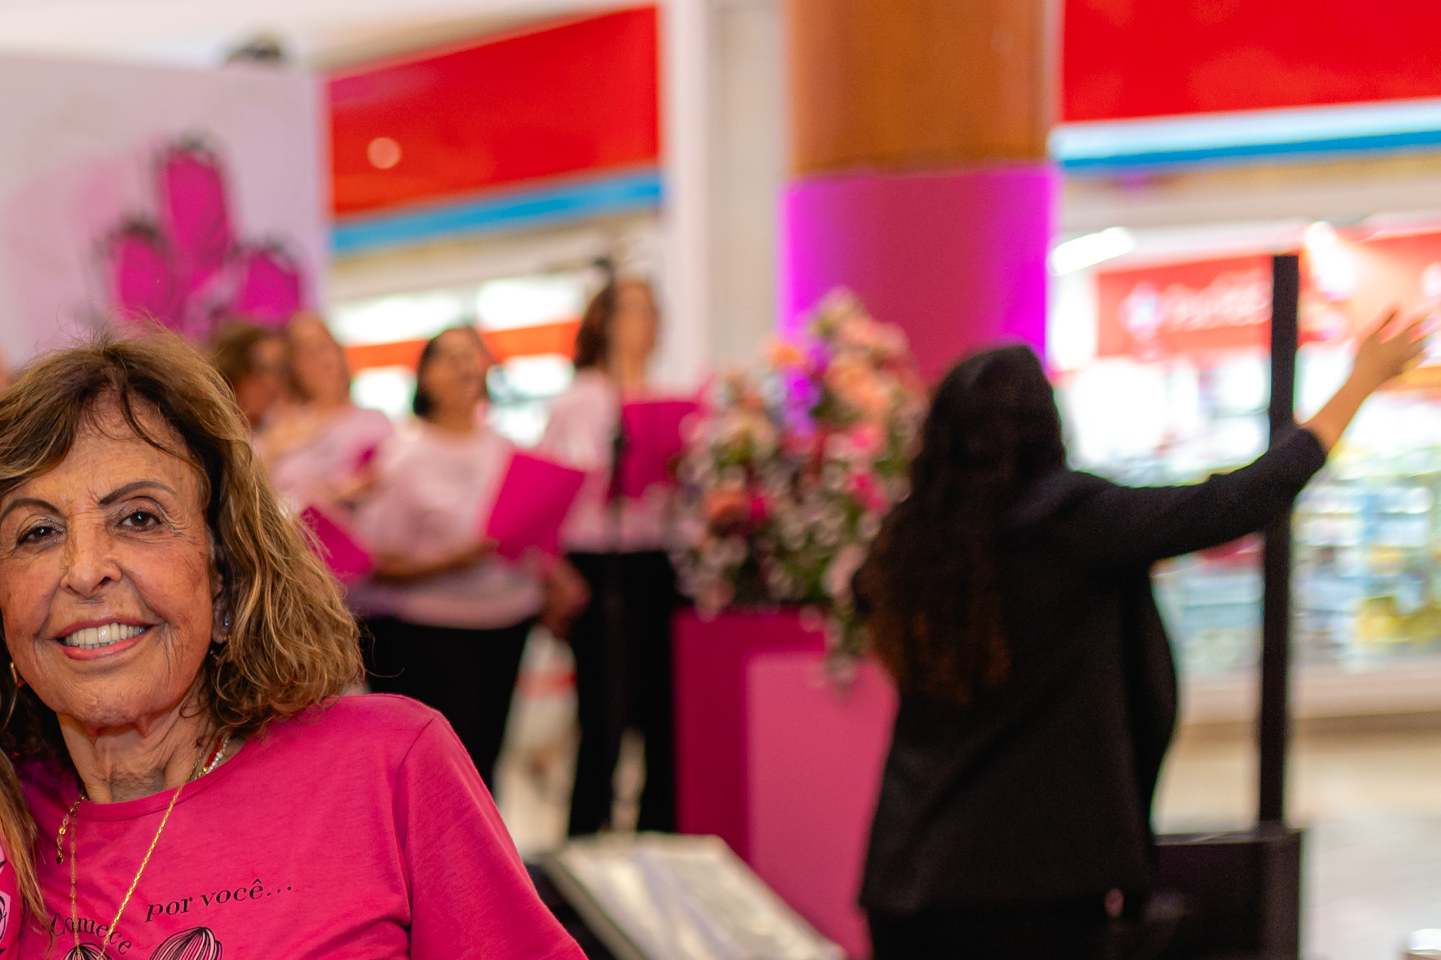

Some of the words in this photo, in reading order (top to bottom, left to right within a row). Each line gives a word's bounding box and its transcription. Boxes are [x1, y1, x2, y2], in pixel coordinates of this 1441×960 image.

[51, 911, 133, 956] Comece
[144, 896, 193, 923] por
[200, 878, 292, 907] você...
